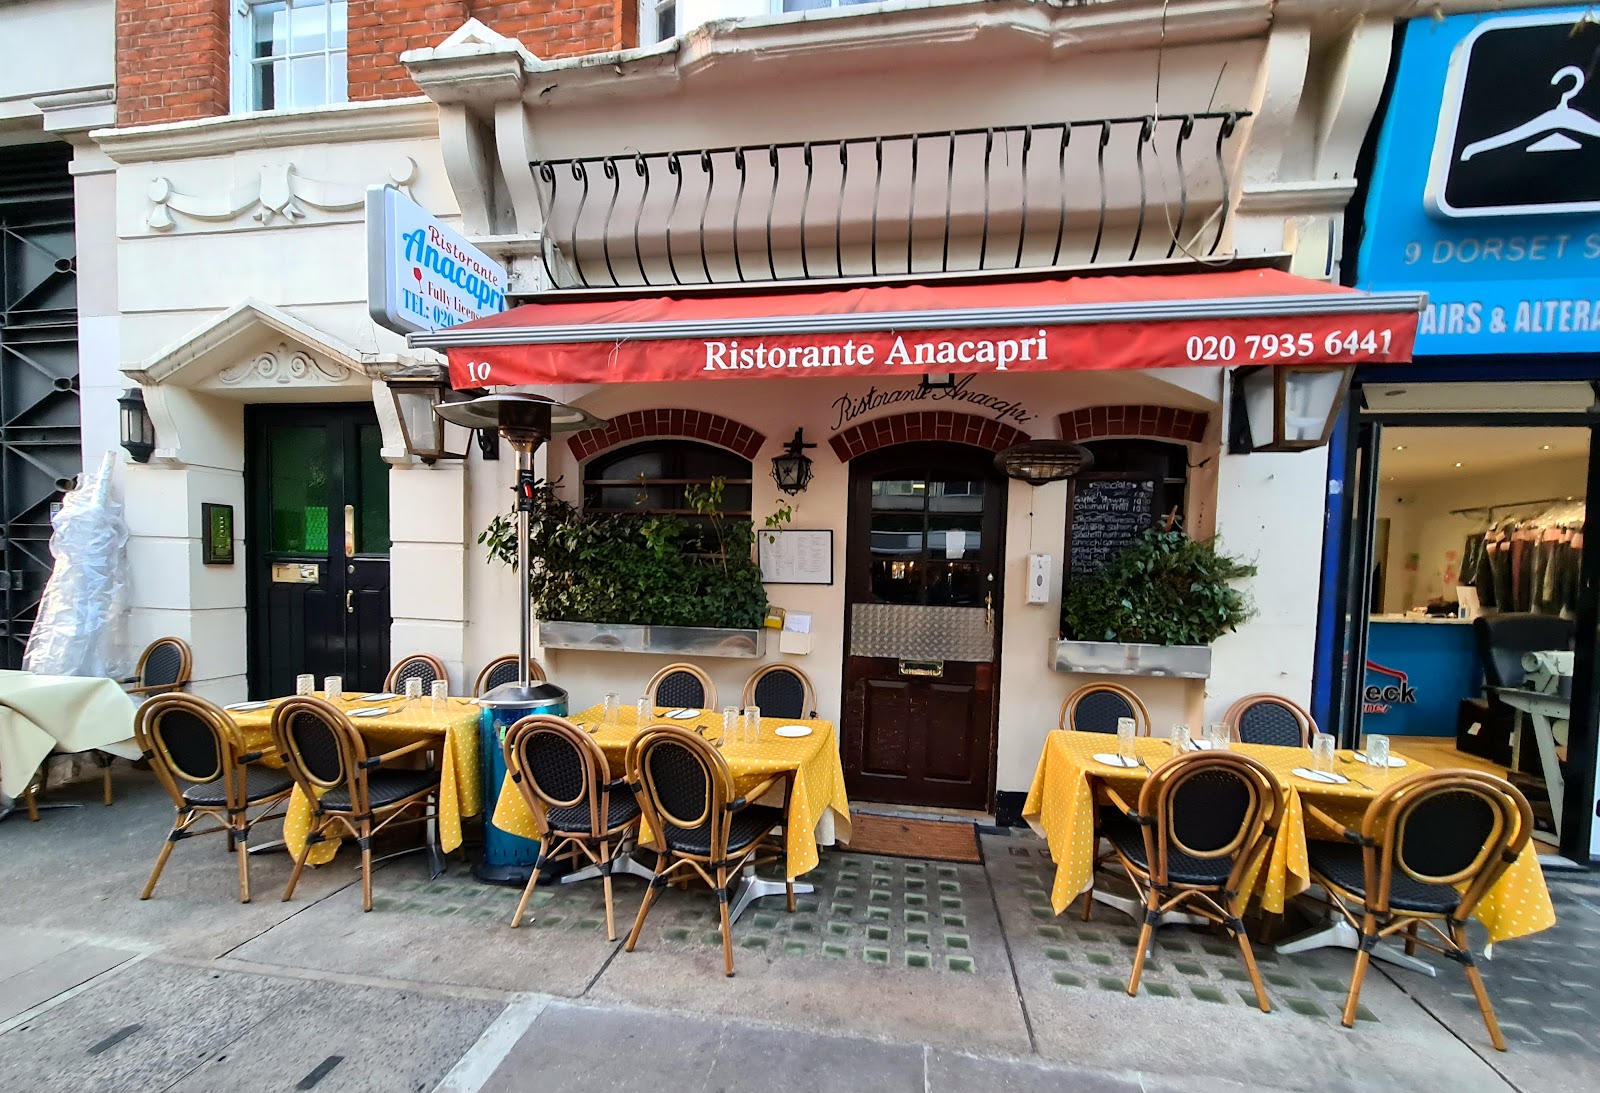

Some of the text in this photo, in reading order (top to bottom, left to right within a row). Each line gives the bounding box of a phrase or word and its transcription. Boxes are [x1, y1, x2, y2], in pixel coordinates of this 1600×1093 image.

[428, 225, 498, 287] Ristorante
[1405, 241, 1422, 265] 9
[1432, 233, 1572, 264] DORSET
[402, 229, 506, 313] Anacapri
[402, 288, 454, 329] TEL: 020
[428, 281, 452, 309] Fully
[1489, 304, 1508, 334] &
[703, 329, 1049, 371] Ristorante Anacapri
[1186, 328, 1393, 361] 020 7935 6441
[466, 361, 492, 382] 10
[831, 372, 1035, 431] Ristorante Anacapri
